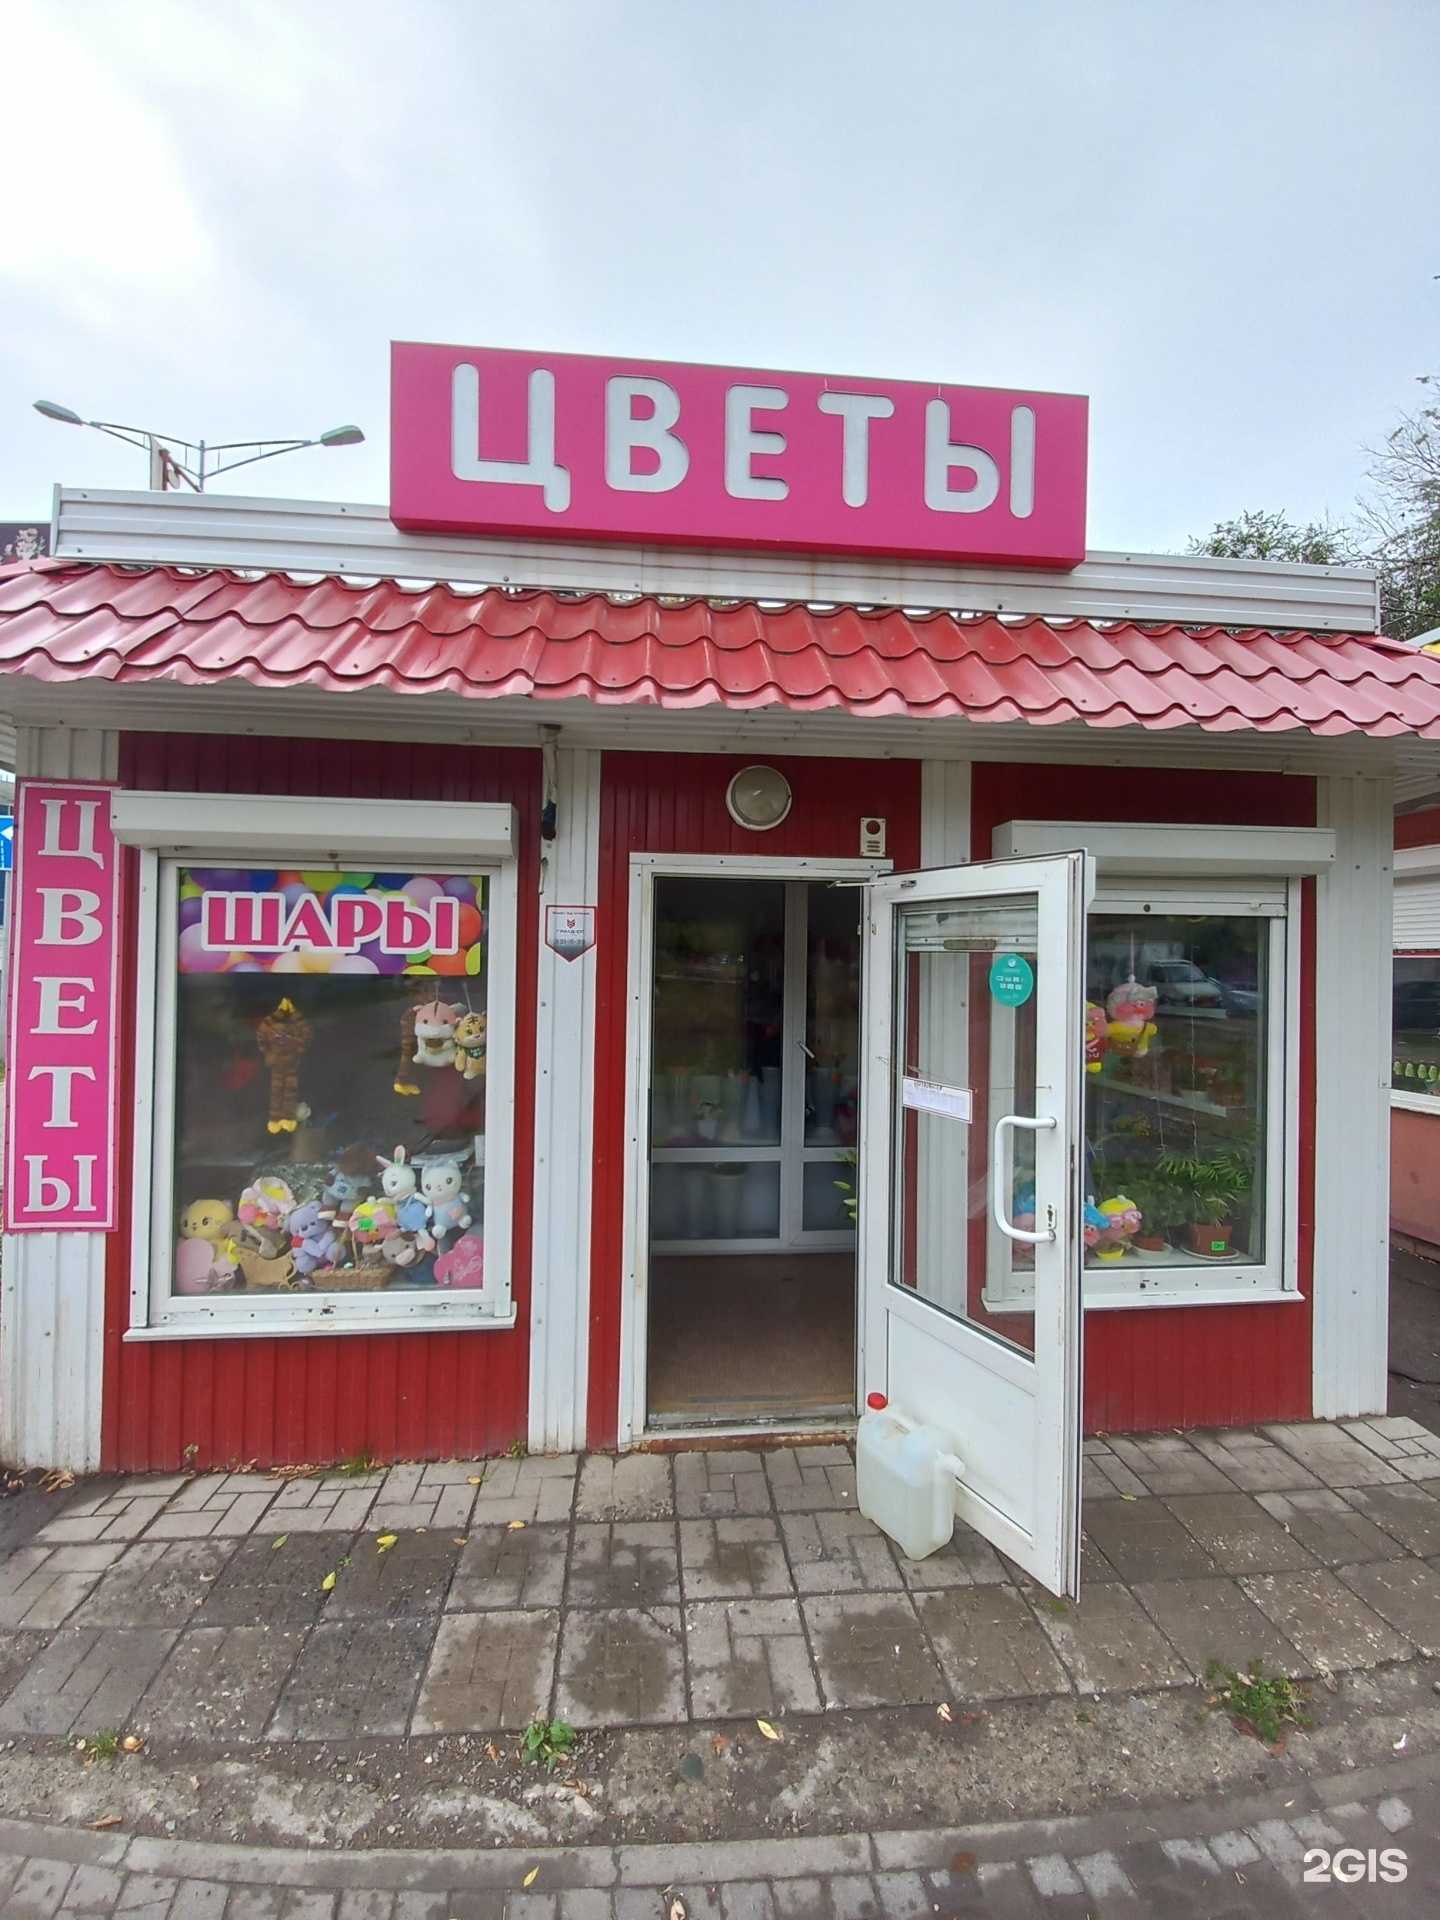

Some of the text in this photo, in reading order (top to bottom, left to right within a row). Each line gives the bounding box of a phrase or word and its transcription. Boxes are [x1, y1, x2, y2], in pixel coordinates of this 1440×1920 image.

[452, 362, 1036, 519] ЦВЕТЫ
[205, 894, 457, 952] ШАРЫ
[22, 799, 105, 1213] ЦВЕТЫ
